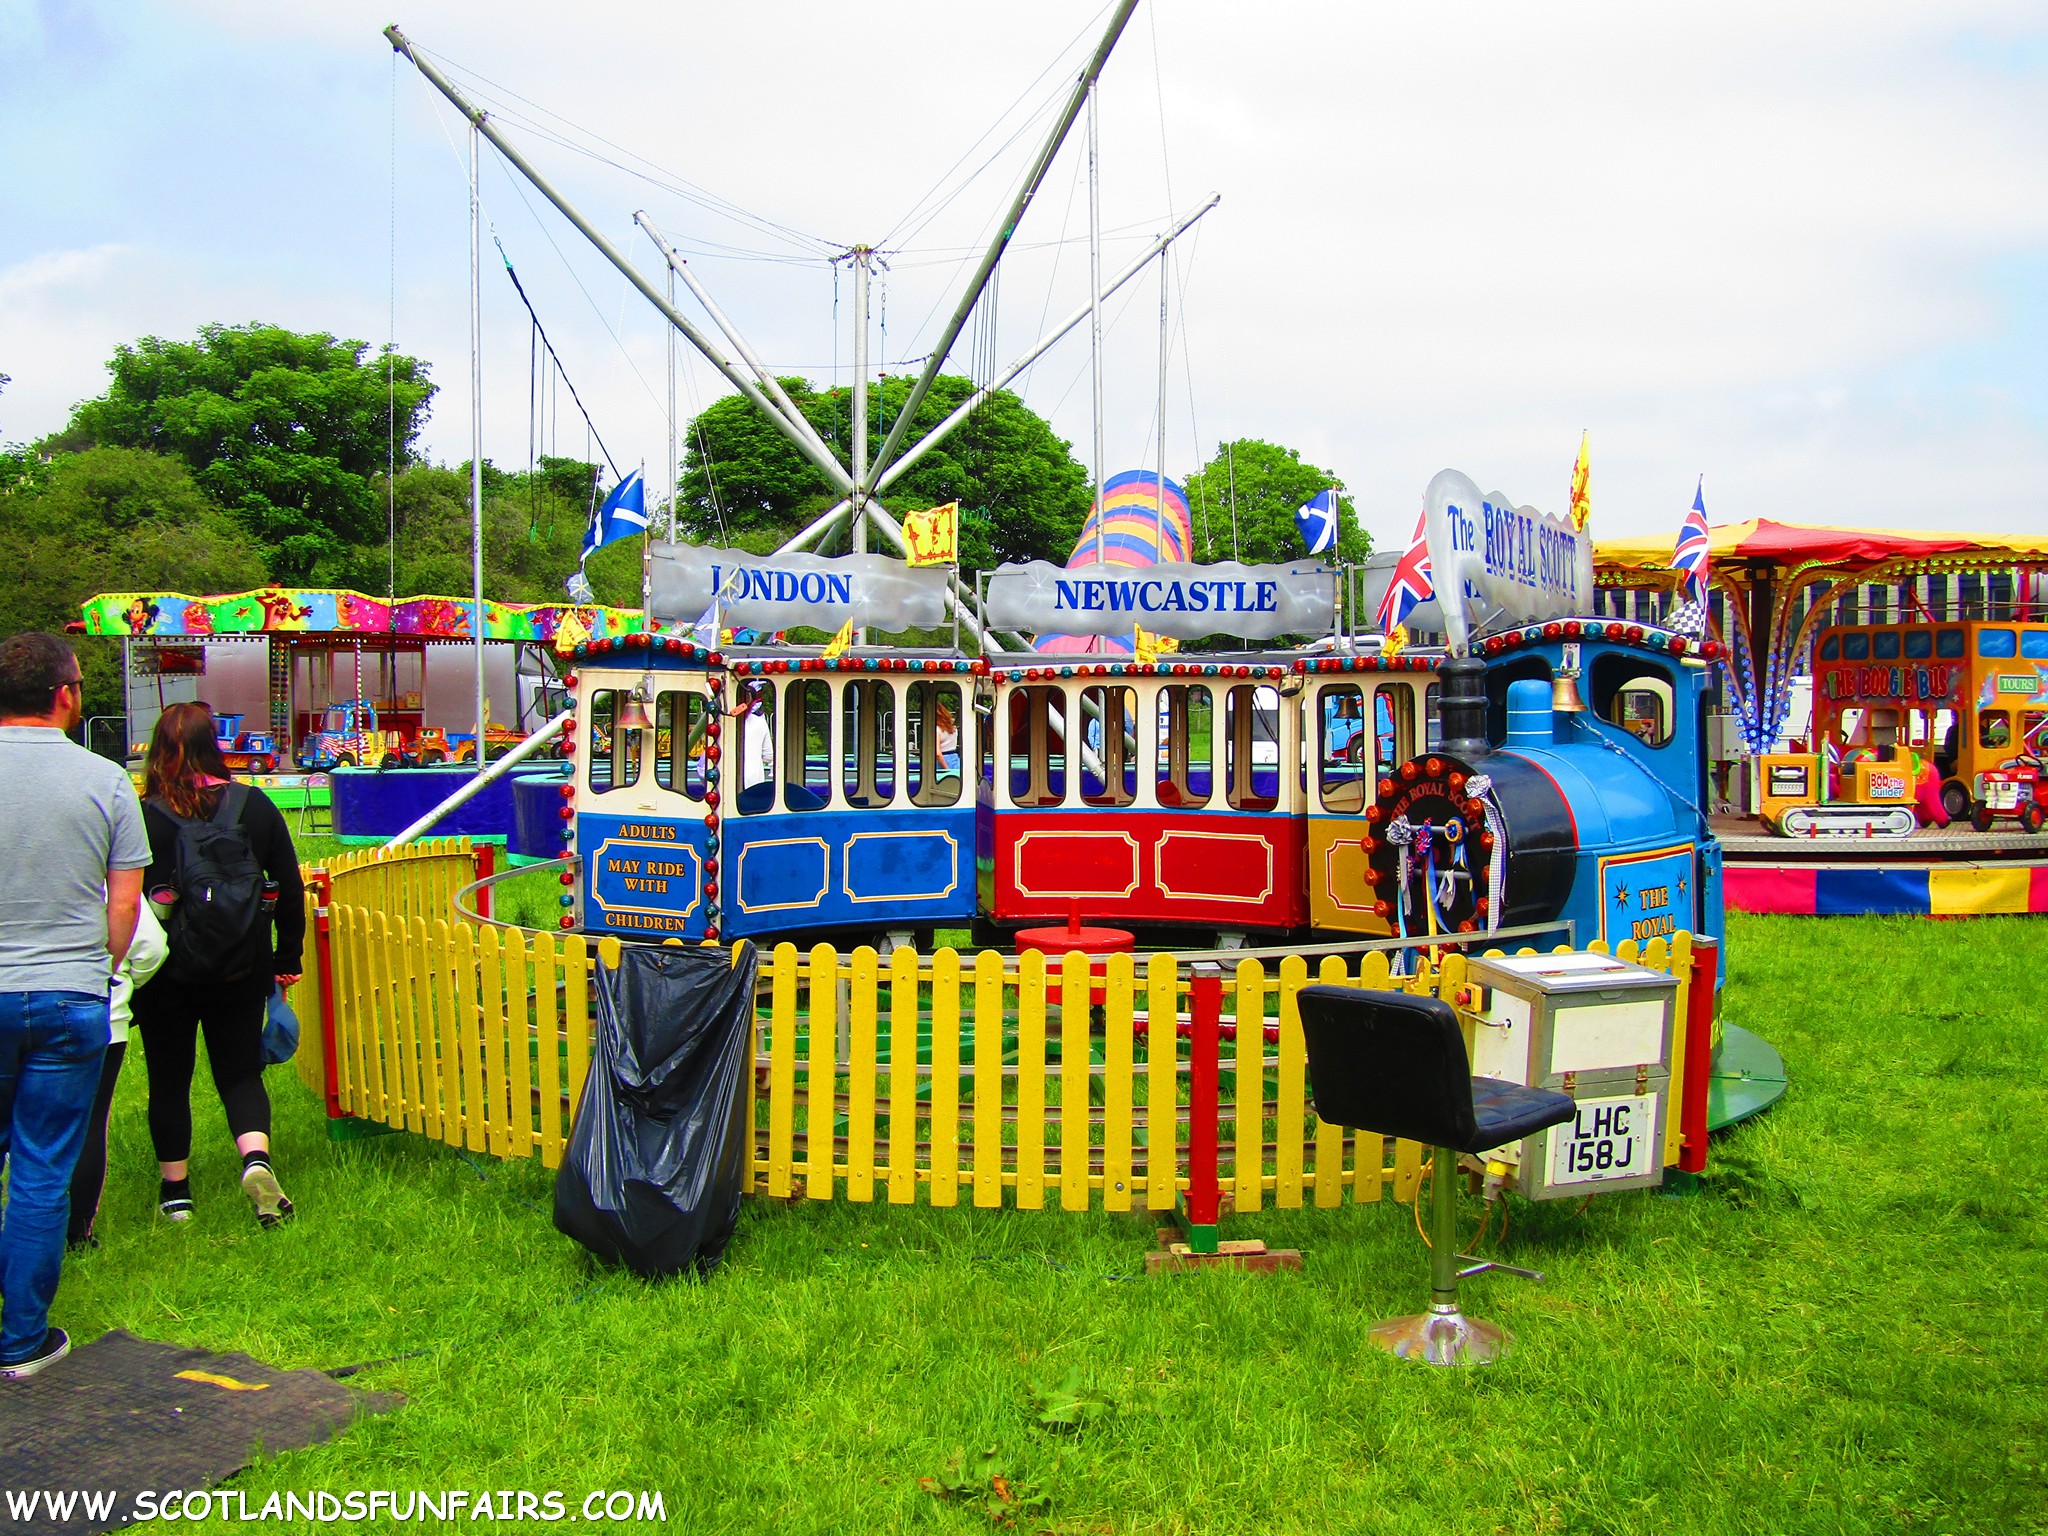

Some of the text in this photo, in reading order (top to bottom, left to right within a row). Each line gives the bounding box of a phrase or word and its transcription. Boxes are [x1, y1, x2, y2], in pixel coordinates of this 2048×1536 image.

[1447, 501, 1577, 601] The ROYAL SCOTT
[1054, 580, 1278, 613] NEWCASTLE
[1827, 668, 1855, 699] THE
[1860, 665, 1914, 697] BOOGIE
[2001, 677, 2035, 690] TOURS
[1871, 772, 1889, 788] Bob
[1871, 788, 1904, 797] builder
[1409, 781, 1445, 802] ROYAL
[1448, 789, 1482, 832] SCOT
[618, 823, 676, 840] ADULTS
[608, 859, 686, 877] MAY RIDE
[624, 877, 669, 894] WITH
[1639, 885, 1669, 911] THE
[605, 912, 686, 932] CHILDREN
[1631, 913, 1677, 941] ROYAL
[1575, 1105, 1631, 1140] LHC
[1568, 1137, 1633, 1173] 158J
